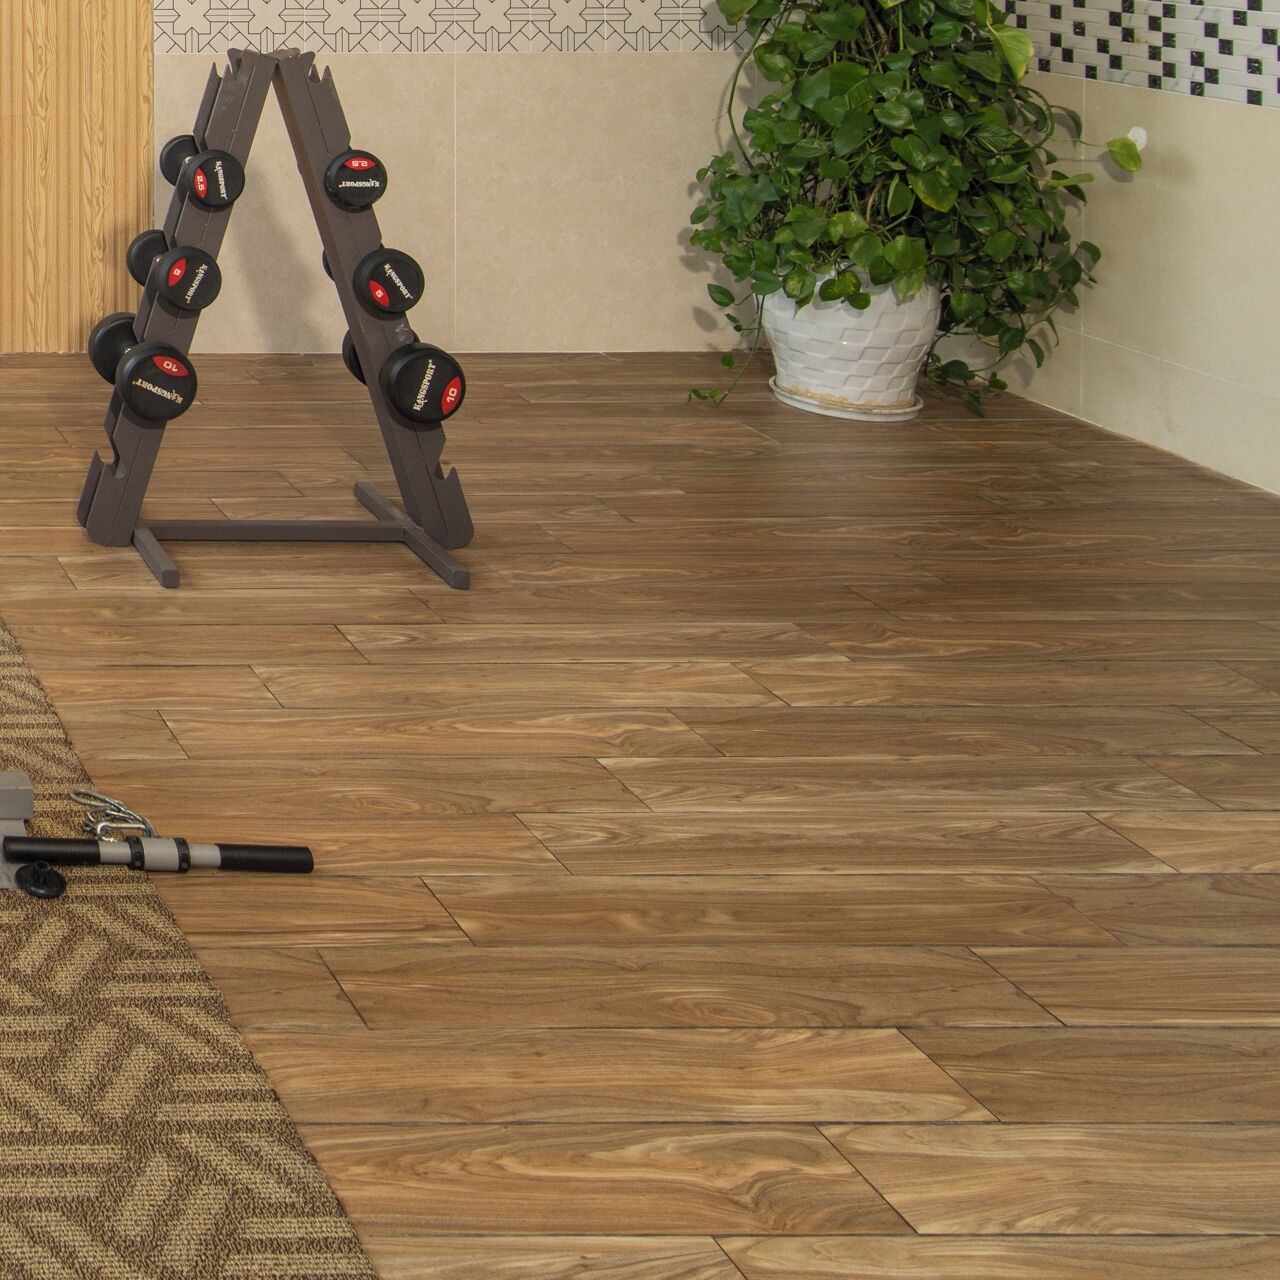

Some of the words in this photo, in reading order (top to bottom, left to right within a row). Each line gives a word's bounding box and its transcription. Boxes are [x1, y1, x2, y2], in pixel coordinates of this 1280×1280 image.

[196, 175, 205, 191] 2.5
[163, 360, 178, 372] 10
[446, 387, 458, 403] 10
